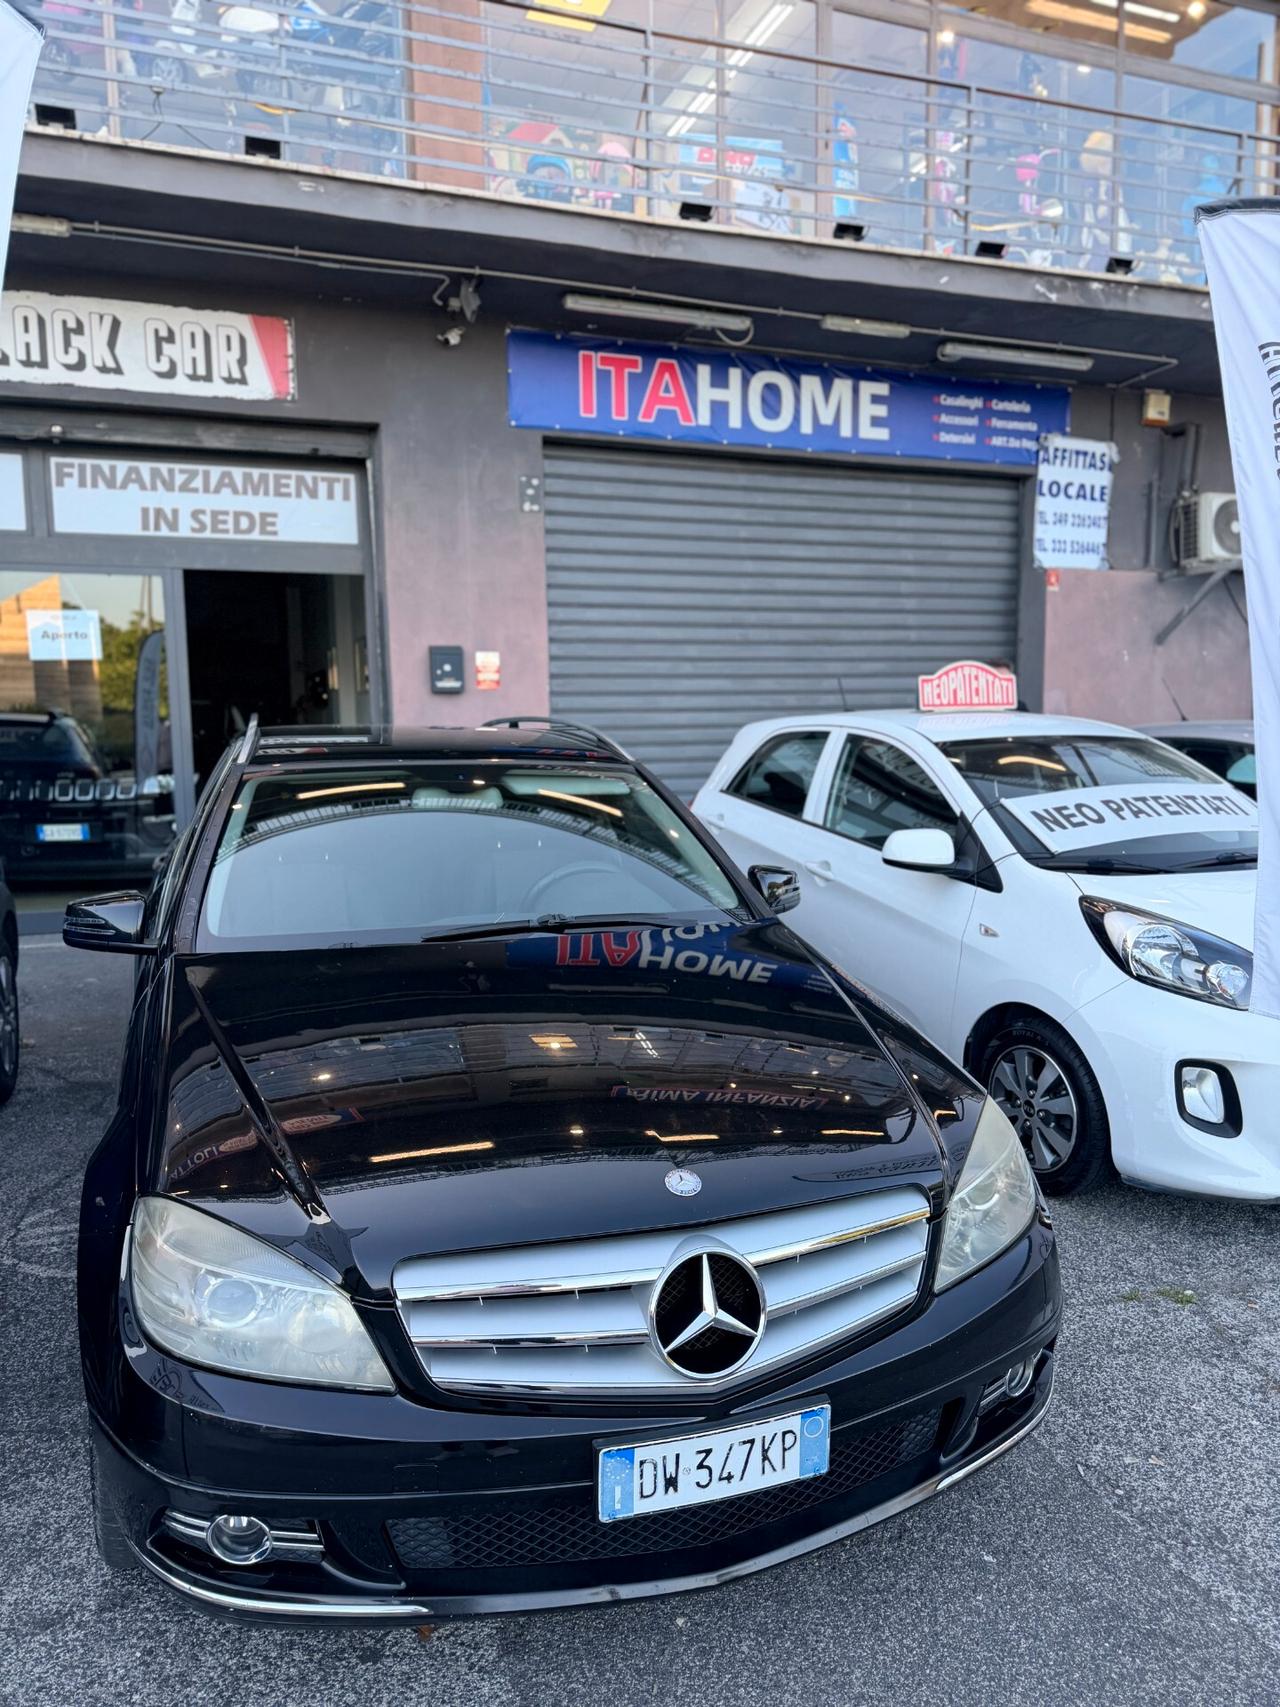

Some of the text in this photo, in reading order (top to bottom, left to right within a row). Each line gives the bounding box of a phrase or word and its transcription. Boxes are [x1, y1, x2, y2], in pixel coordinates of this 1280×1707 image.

[0, 305, 249, 386] ACK CAR
[578, 350, 891, 441] ITAHOME
[53, 461, 351, 502] FINANZIAMENTI
[1037, 479, 1108, 502] LOCALE
[140, 506, 279, 536] IN SEDE
[41, 630, 88, 642] Aperto
[1030, 795, 1250, 832] NEO PATENTATI
[638, 1429, 798, 1500] DW 347KP
